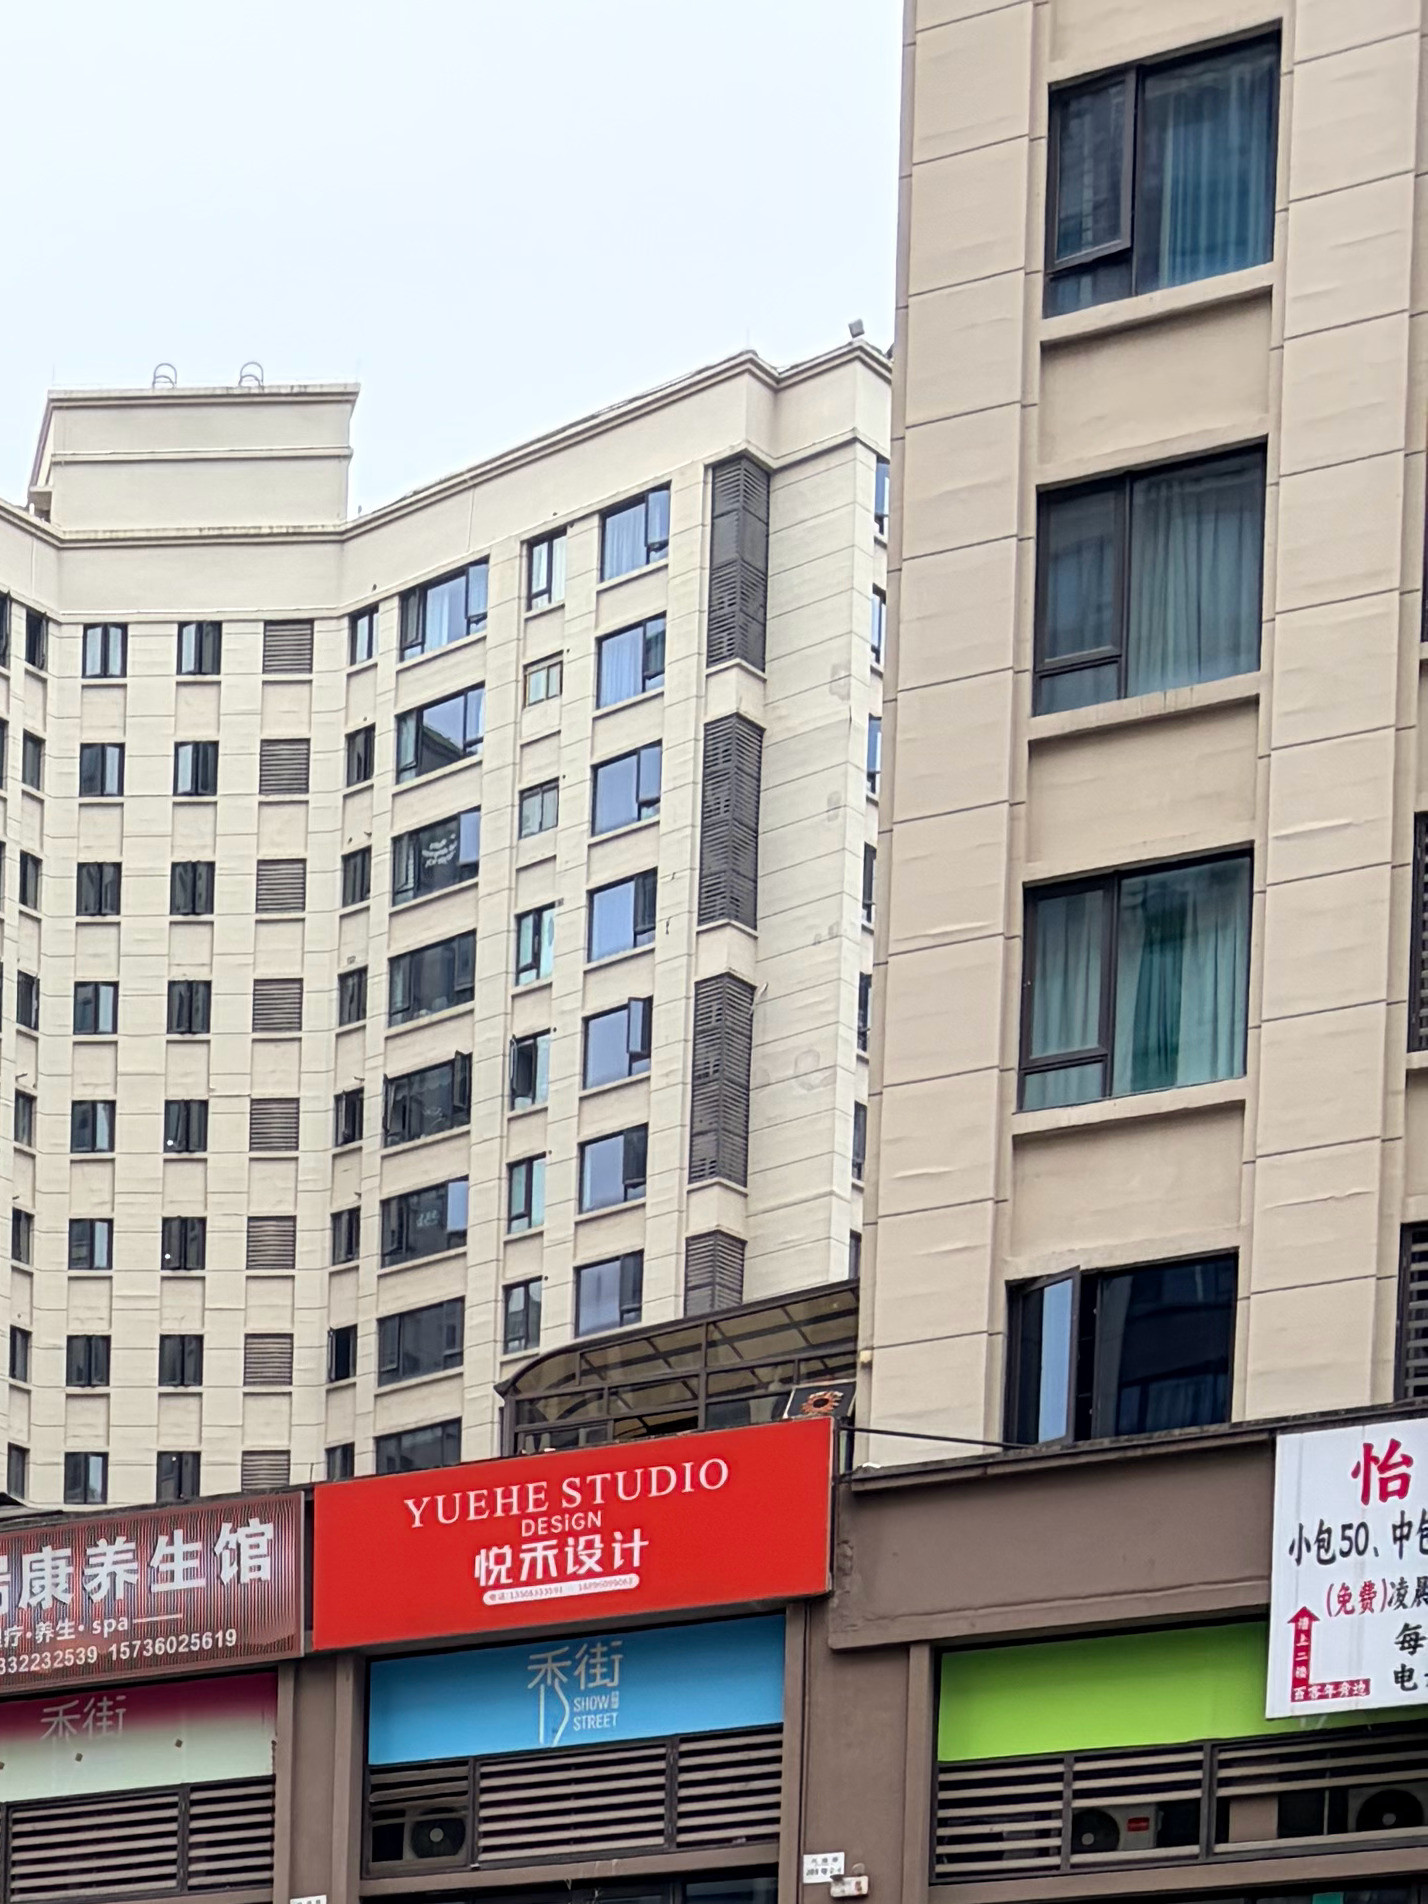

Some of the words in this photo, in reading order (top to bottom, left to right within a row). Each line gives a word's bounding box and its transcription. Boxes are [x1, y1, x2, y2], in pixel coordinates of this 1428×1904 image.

[1350, 1438, 1414, 1506] 怡
[404, 1480, 549, 1529] YUEHE
[561, 1457, 729, 1509] STUDIO
[474, 1528, 650, 1587] 悦禾设计
[108, 1628, 238, 1662] 15736025619
[1393, 1662, 1428, 1693] 电
[573, 1695, 610, 1713] SHOW
[573, 1711, 619, 1731] STREET
